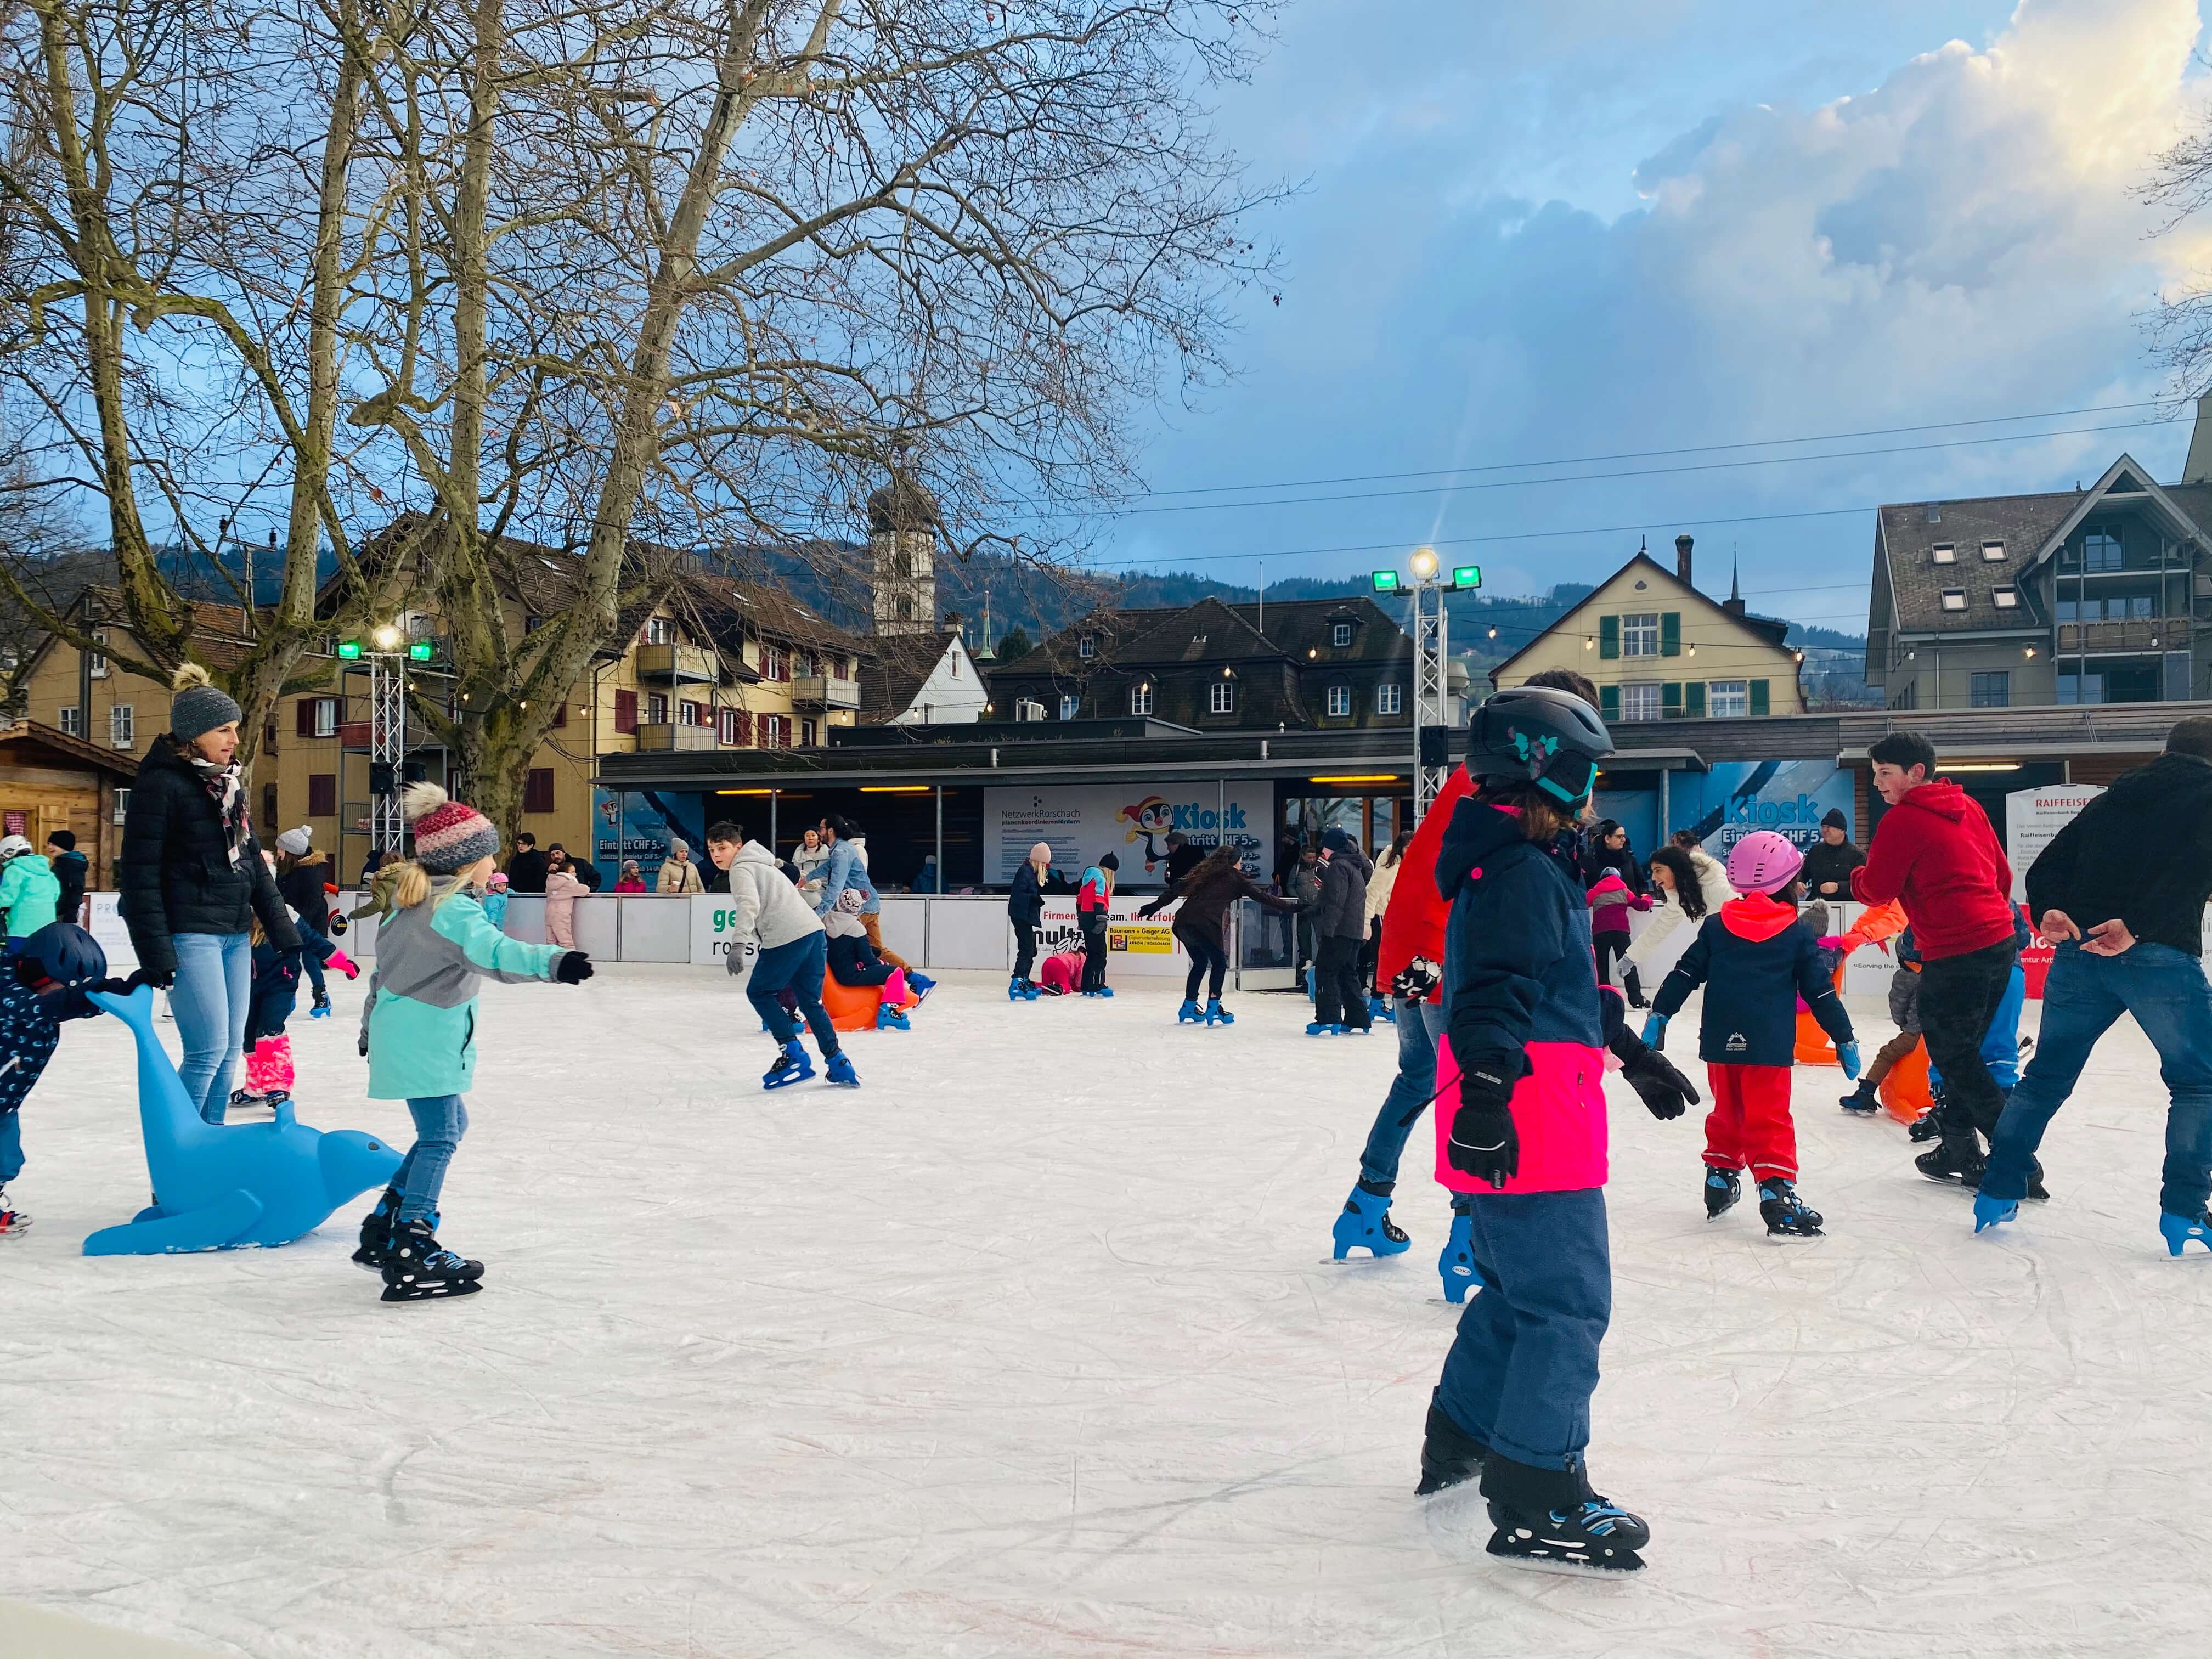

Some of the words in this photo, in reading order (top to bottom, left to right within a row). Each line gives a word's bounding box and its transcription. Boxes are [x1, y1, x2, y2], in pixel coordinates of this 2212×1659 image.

[1002, 809, 1080, 819] NetzwerkRorschach
[1724, 794, 1819, 824] Kiosk
[1173, 803, 1247, 830] Kiosk
[634, 840, 650, 850] CHF
[651, 840, 665, 850] 5.-
[1242, 835, 1258, 845] 5.-
[1141, 928, 1160, 936] Geiger
